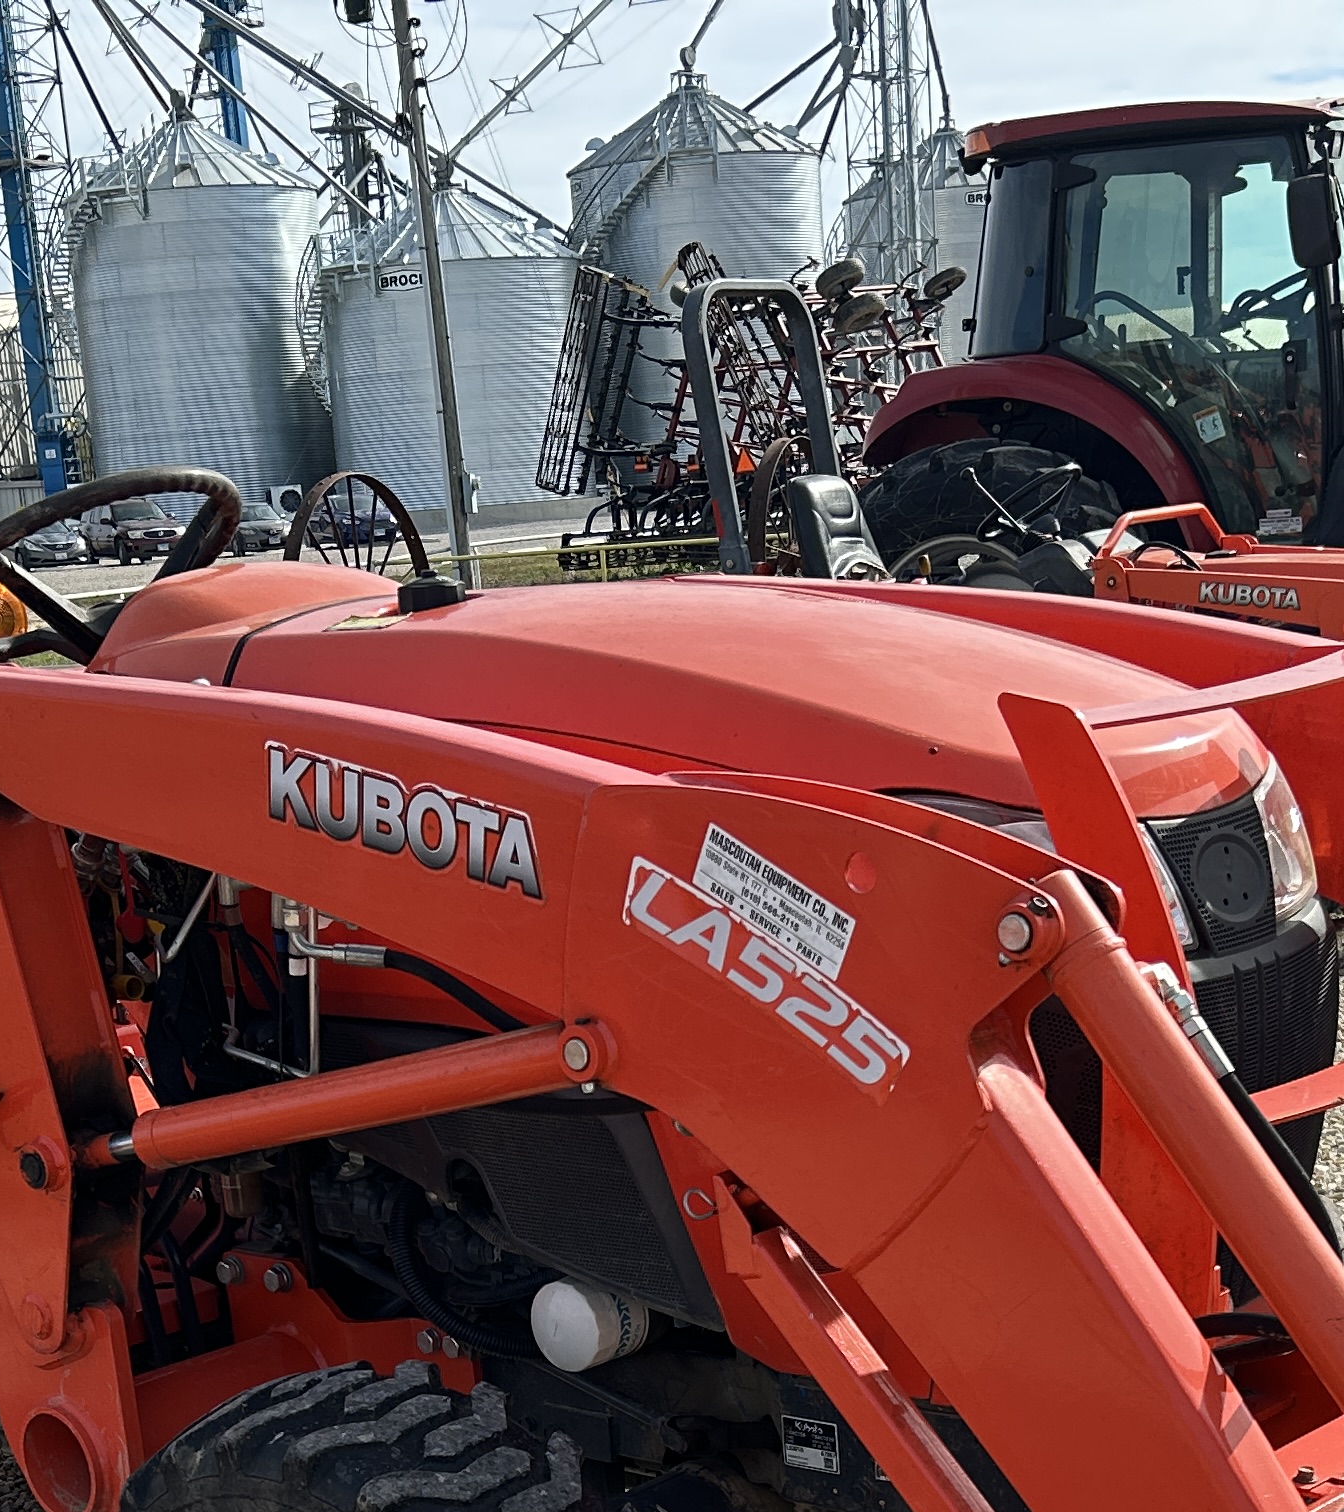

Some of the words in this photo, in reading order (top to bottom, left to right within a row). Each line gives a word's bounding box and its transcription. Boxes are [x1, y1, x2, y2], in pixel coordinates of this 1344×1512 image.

[1199, 581, 1301, 611] KUBOTA
[268, 745, 543, 900] KUBOTA
[709, 828, 762, 873] MASCOUTAH
[762, 864, 813, 907] EQUIPMENT
[831, 911, 849, 935] INC.
[710, 882, 735, 906] SALES
[749, 909, 782, 939] SERVICE
[795, 941, 823, 967] PARTS
[630, 872, 901, 1084] LA525
